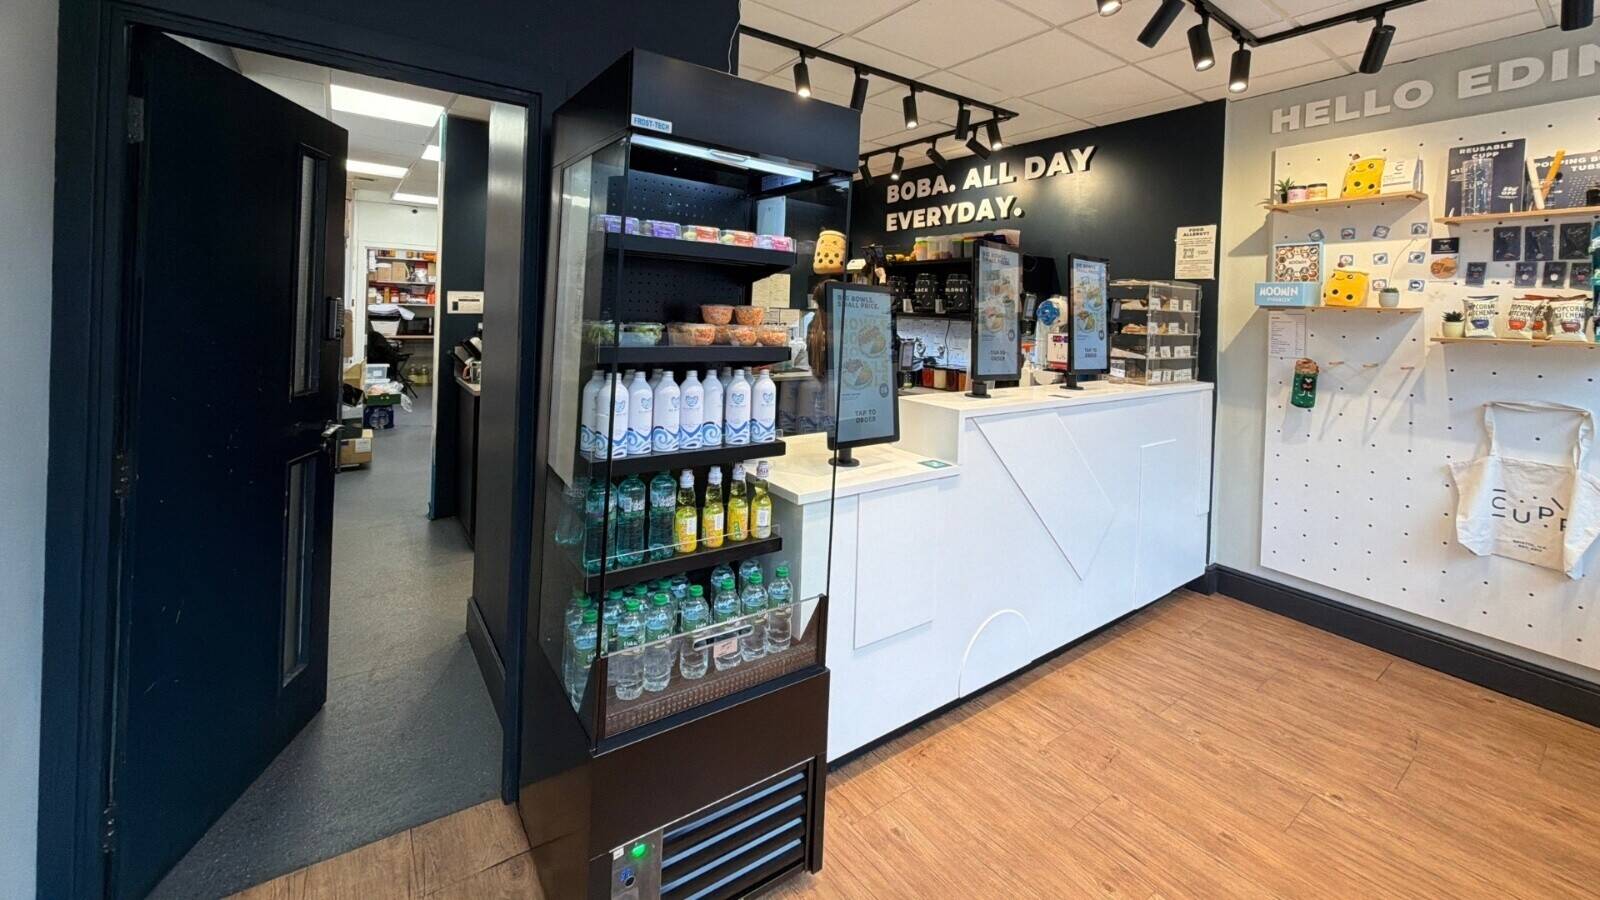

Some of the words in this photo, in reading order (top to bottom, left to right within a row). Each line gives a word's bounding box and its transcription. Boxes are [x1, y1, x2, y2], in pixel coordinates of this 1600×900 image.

[1271, 79, 1435, 134] HELLO
[633, 116, 671, 131] FROST-TECH
[1458, 142, 1515, 155] REUSABLE
[1471, 151, 1500, 160] CUPP
[886, 173, 956, 205] BOBA.
[962, 161, 1017, 191] ALL
[1024, 145, 1098, 181] DAY
[886, 196, 1025, 233] EVERYDAY.
[837, 294, 850, 302] BG
[1259, 286, 1299, 297] MOOMIN
[837, 301, 859, 309] SALL
